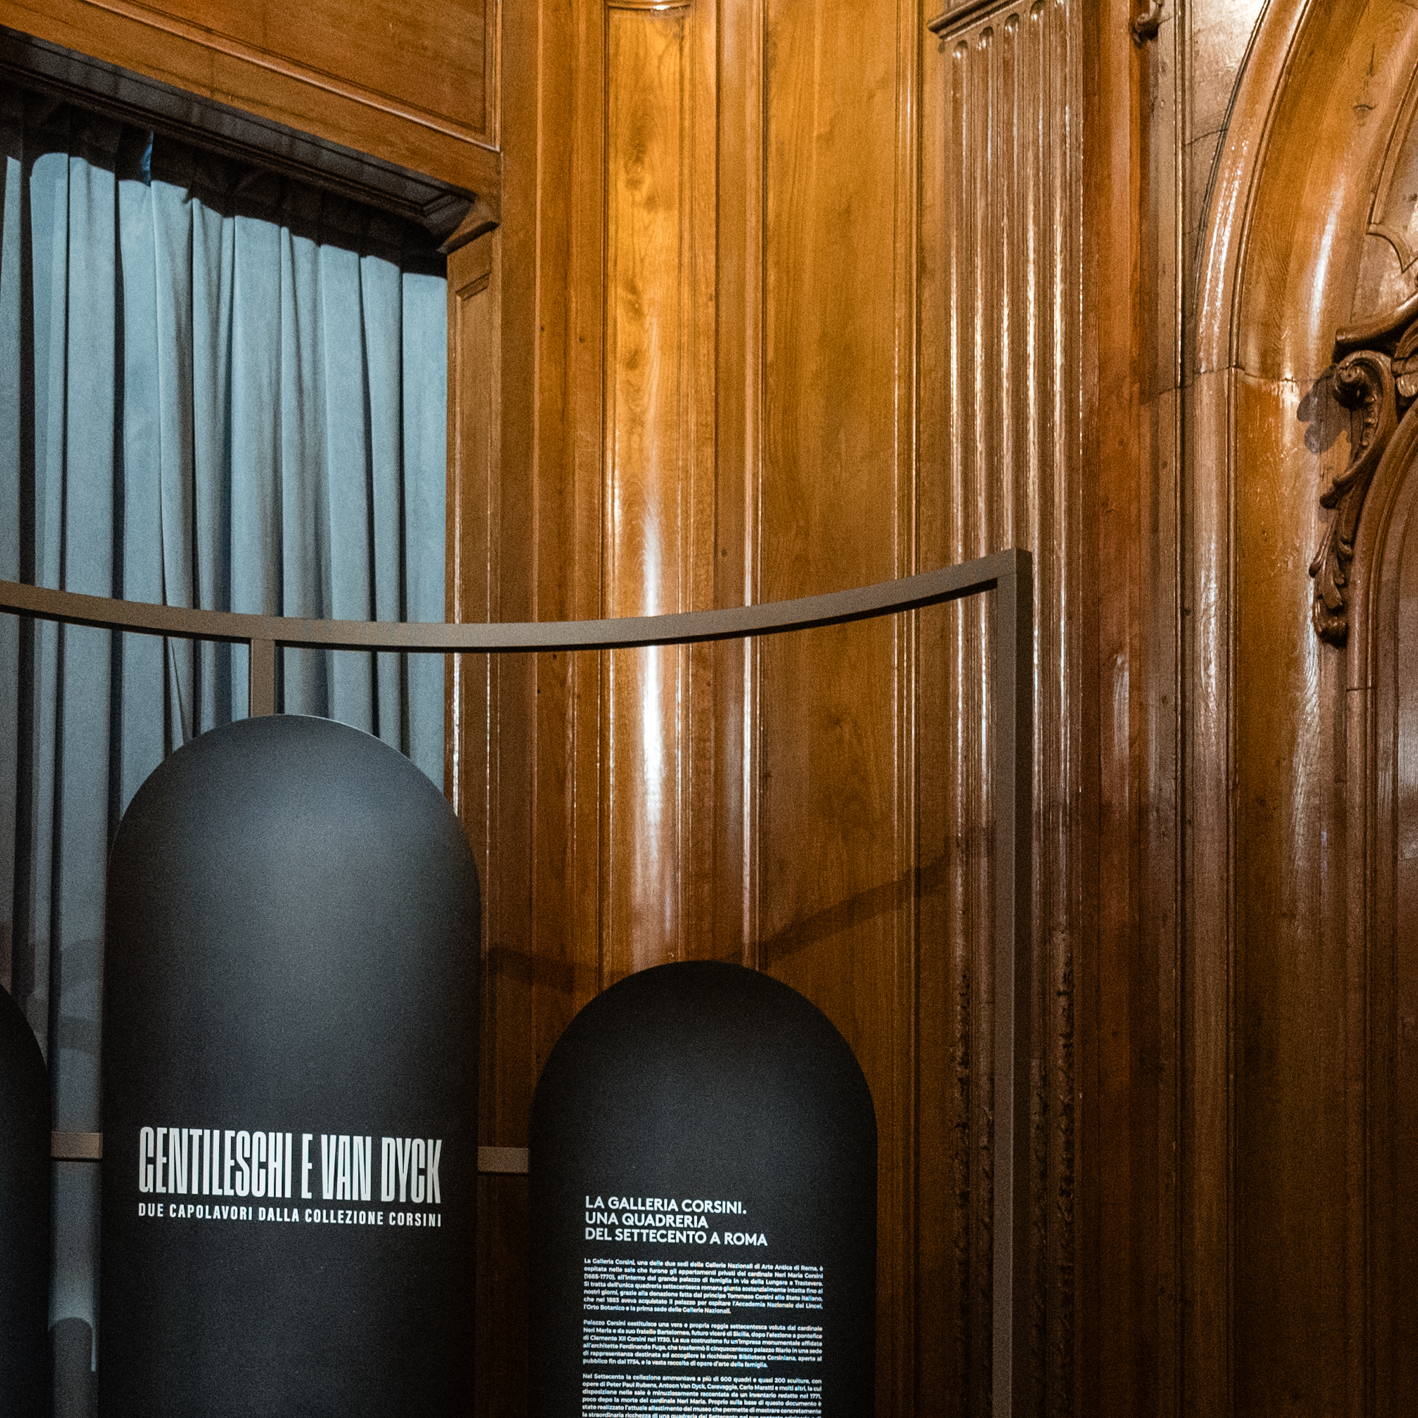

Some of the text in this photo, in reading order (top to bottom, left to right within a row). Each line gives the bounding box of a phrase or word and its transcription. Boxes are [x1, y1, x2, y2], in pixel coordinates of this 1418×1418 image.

[139, 1126, 441, 1203] GENTILESCHI E VAN DYCK
[585, 1195, 746, 1214] LA GALLERIA CORSINI.
[138, 1202, 441, 1227] DUE CAPOLAVORI DALLA COLLEZIONE CORSINI
[585, 1211, 708, 1228] UNA QUADRERIA
[585, 1227, 767, 1246] DEL SETTECENTO A ROMA
